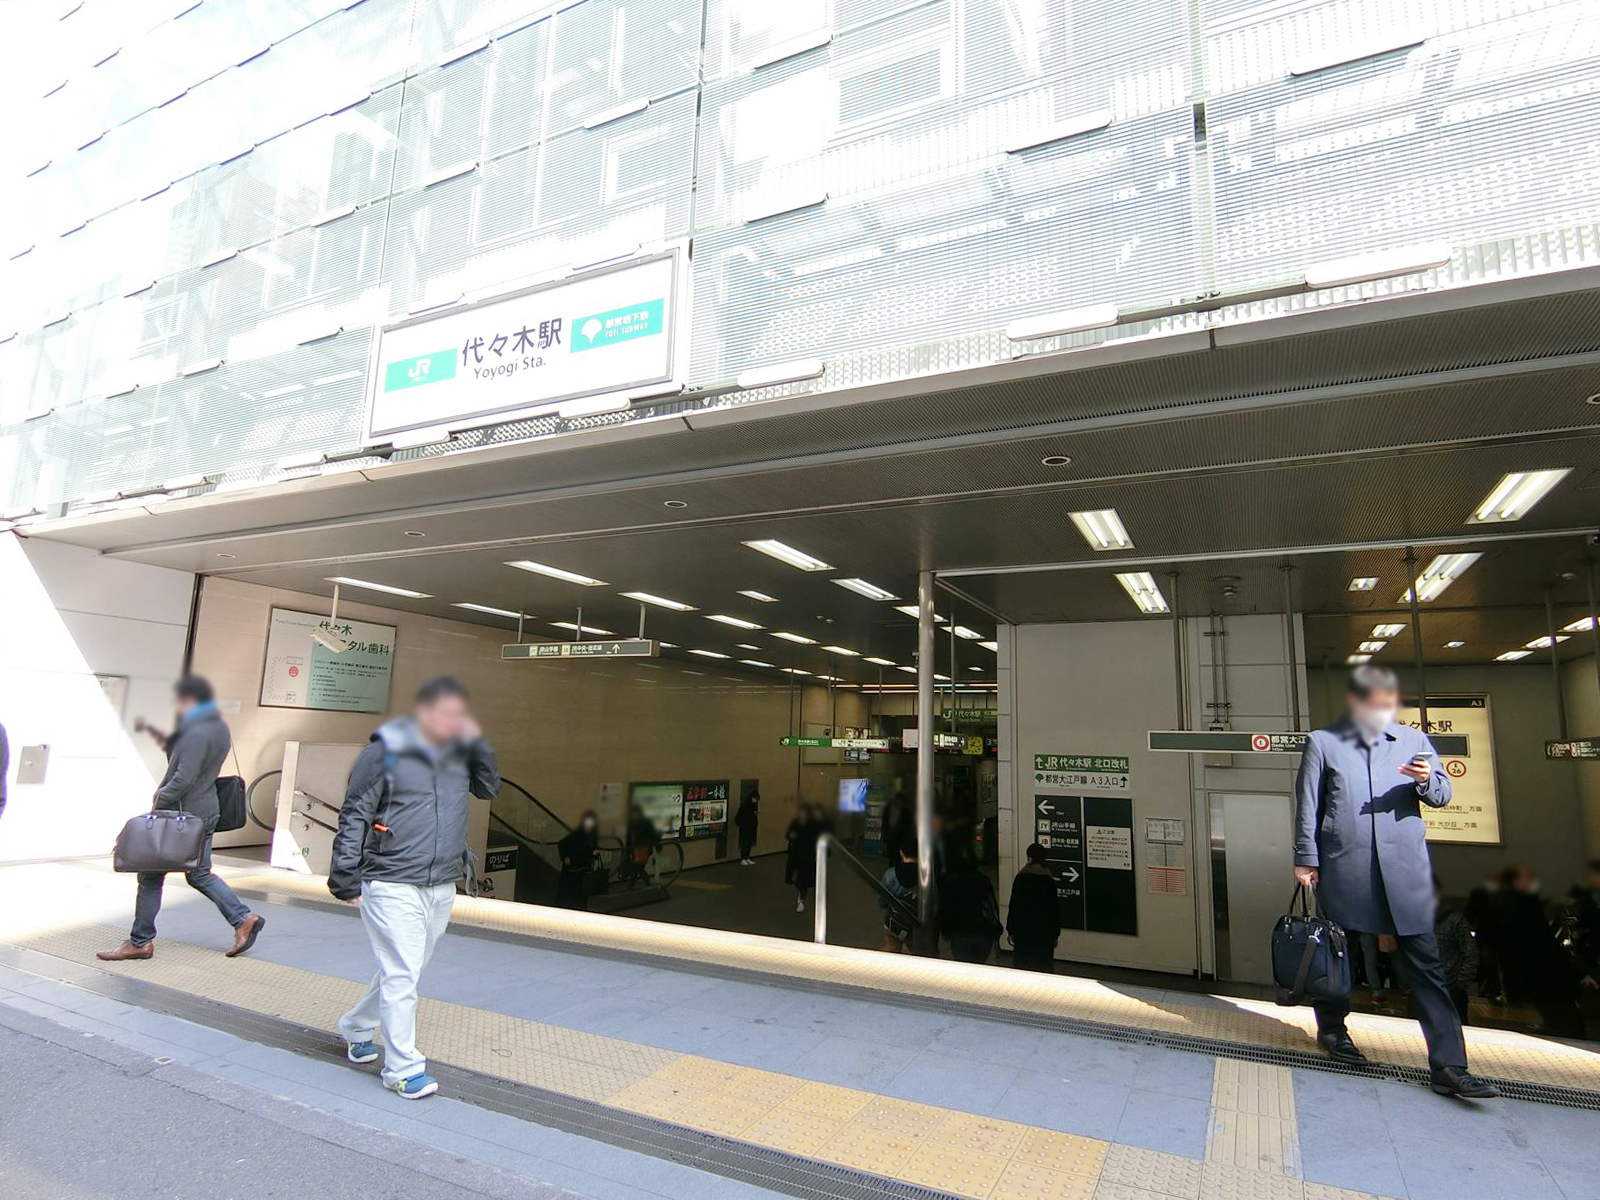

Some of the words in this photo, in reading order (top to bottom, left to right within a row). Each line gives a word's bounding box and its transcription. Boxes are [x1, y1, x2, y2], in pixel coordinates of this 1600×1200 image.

[462, 318, 562, 368] 代々木駅
[408, 358, 431, 378] JR
[474, 359, 518, 381] Yoyogi
[522, 356, 546, 371] Sta.
[1045, 756, 1058, 768] JR
[1060, 757, 1092, 769] 代々木駅
[1094, 758, 1128, 769] 北口改札
[1045, 774, 1088, 785] 都営大江戸線
[490, 853, 511, 864] のりば
